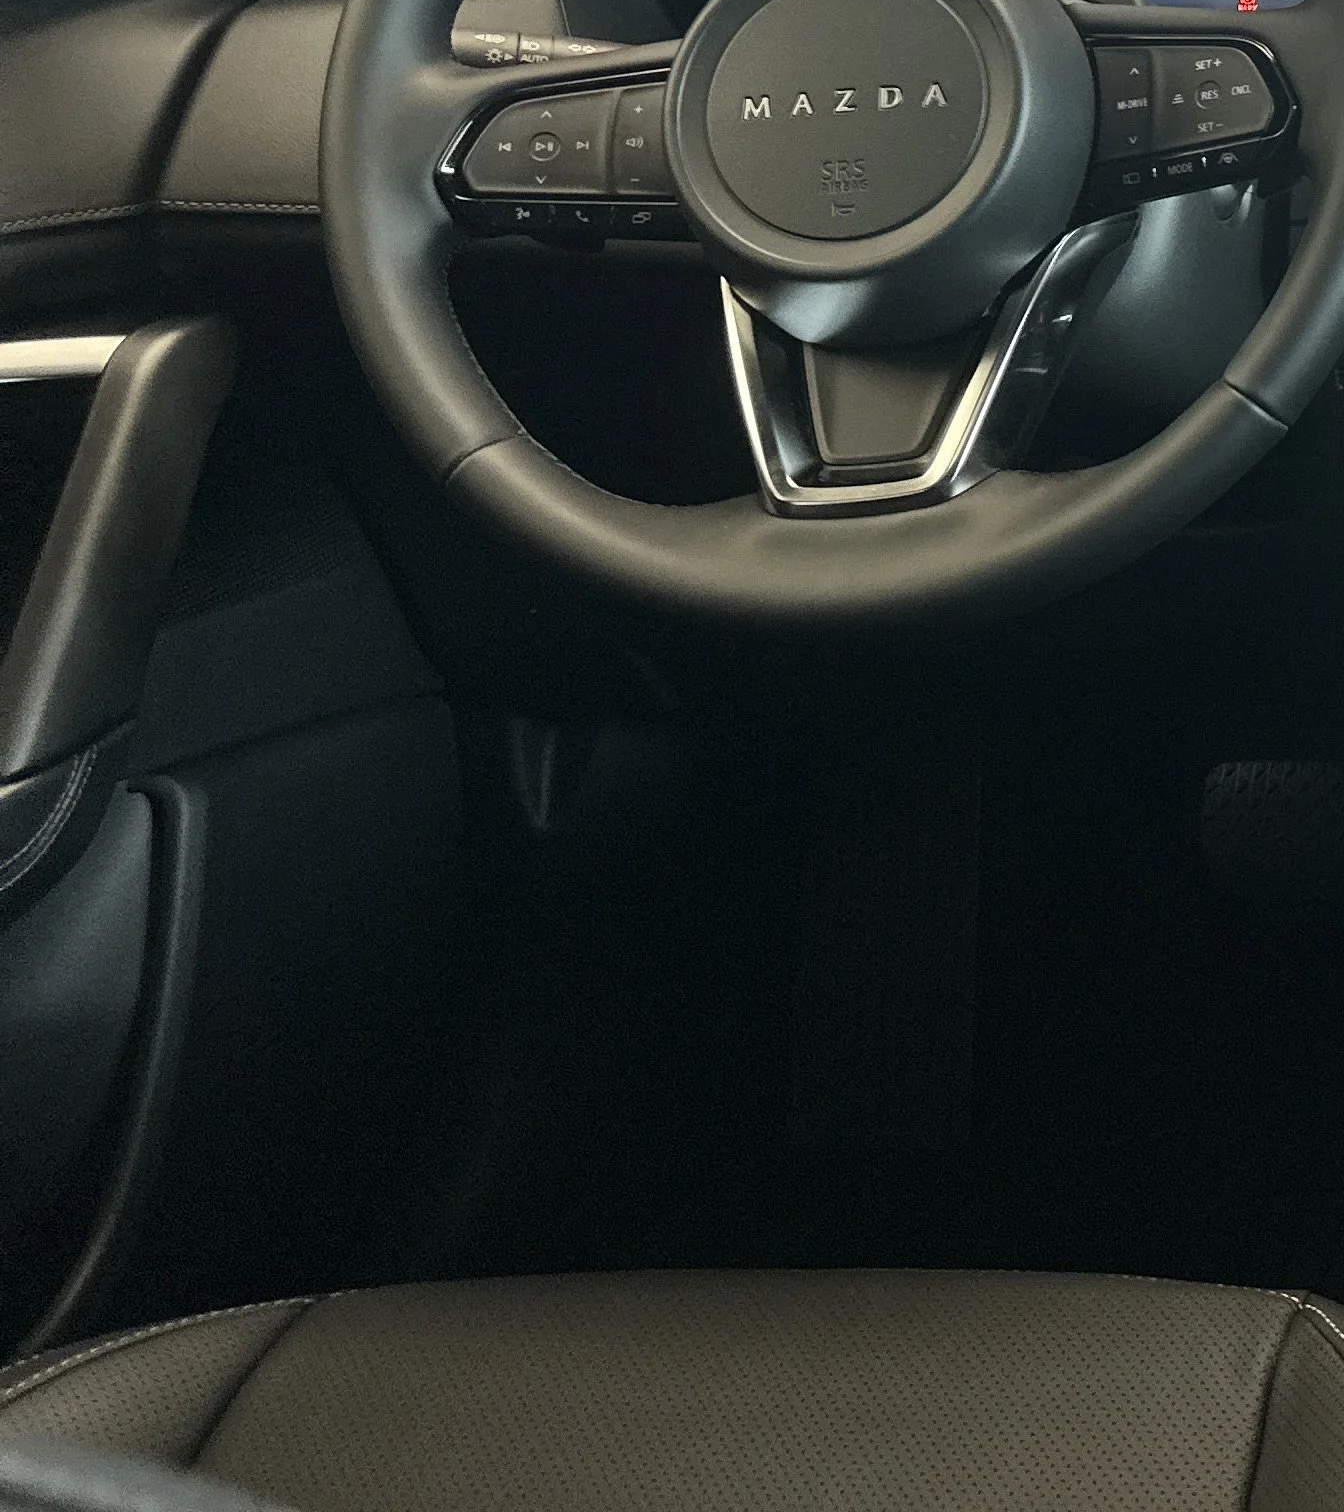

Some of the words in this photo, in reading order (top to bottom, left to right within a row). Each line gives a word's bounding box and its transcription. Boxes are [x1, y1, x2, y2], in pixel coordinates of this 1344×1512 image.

[520, 54, 549, 63] AUTO
[743, 82, 949, 121] MAZDA
[1201, 90, 1219, 101] RES
[821, 158, 866, 182] SRS
[1167, 162, 1193, 175] MODE
